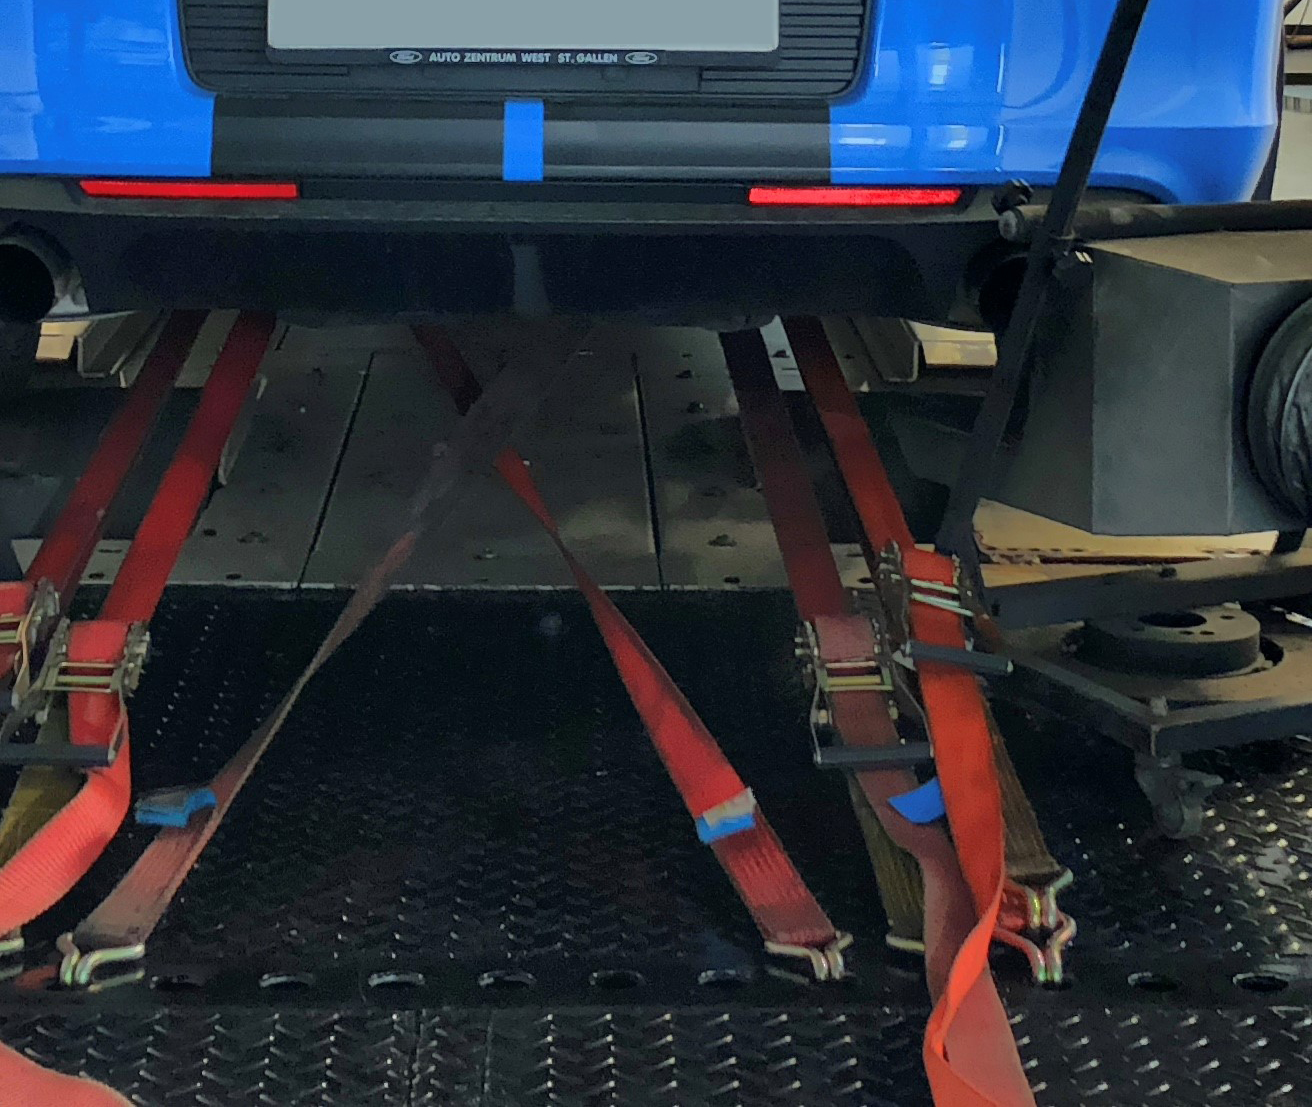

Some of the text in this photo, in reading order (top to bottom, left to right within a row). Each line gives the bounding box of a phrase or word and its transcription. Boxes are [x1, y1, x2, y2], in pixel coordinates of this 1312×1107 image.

[429, 52, 460, 63] AUTO
[464, 53, 517, 63] ZENTRUM
[521, 53, 550, 63] WEST
